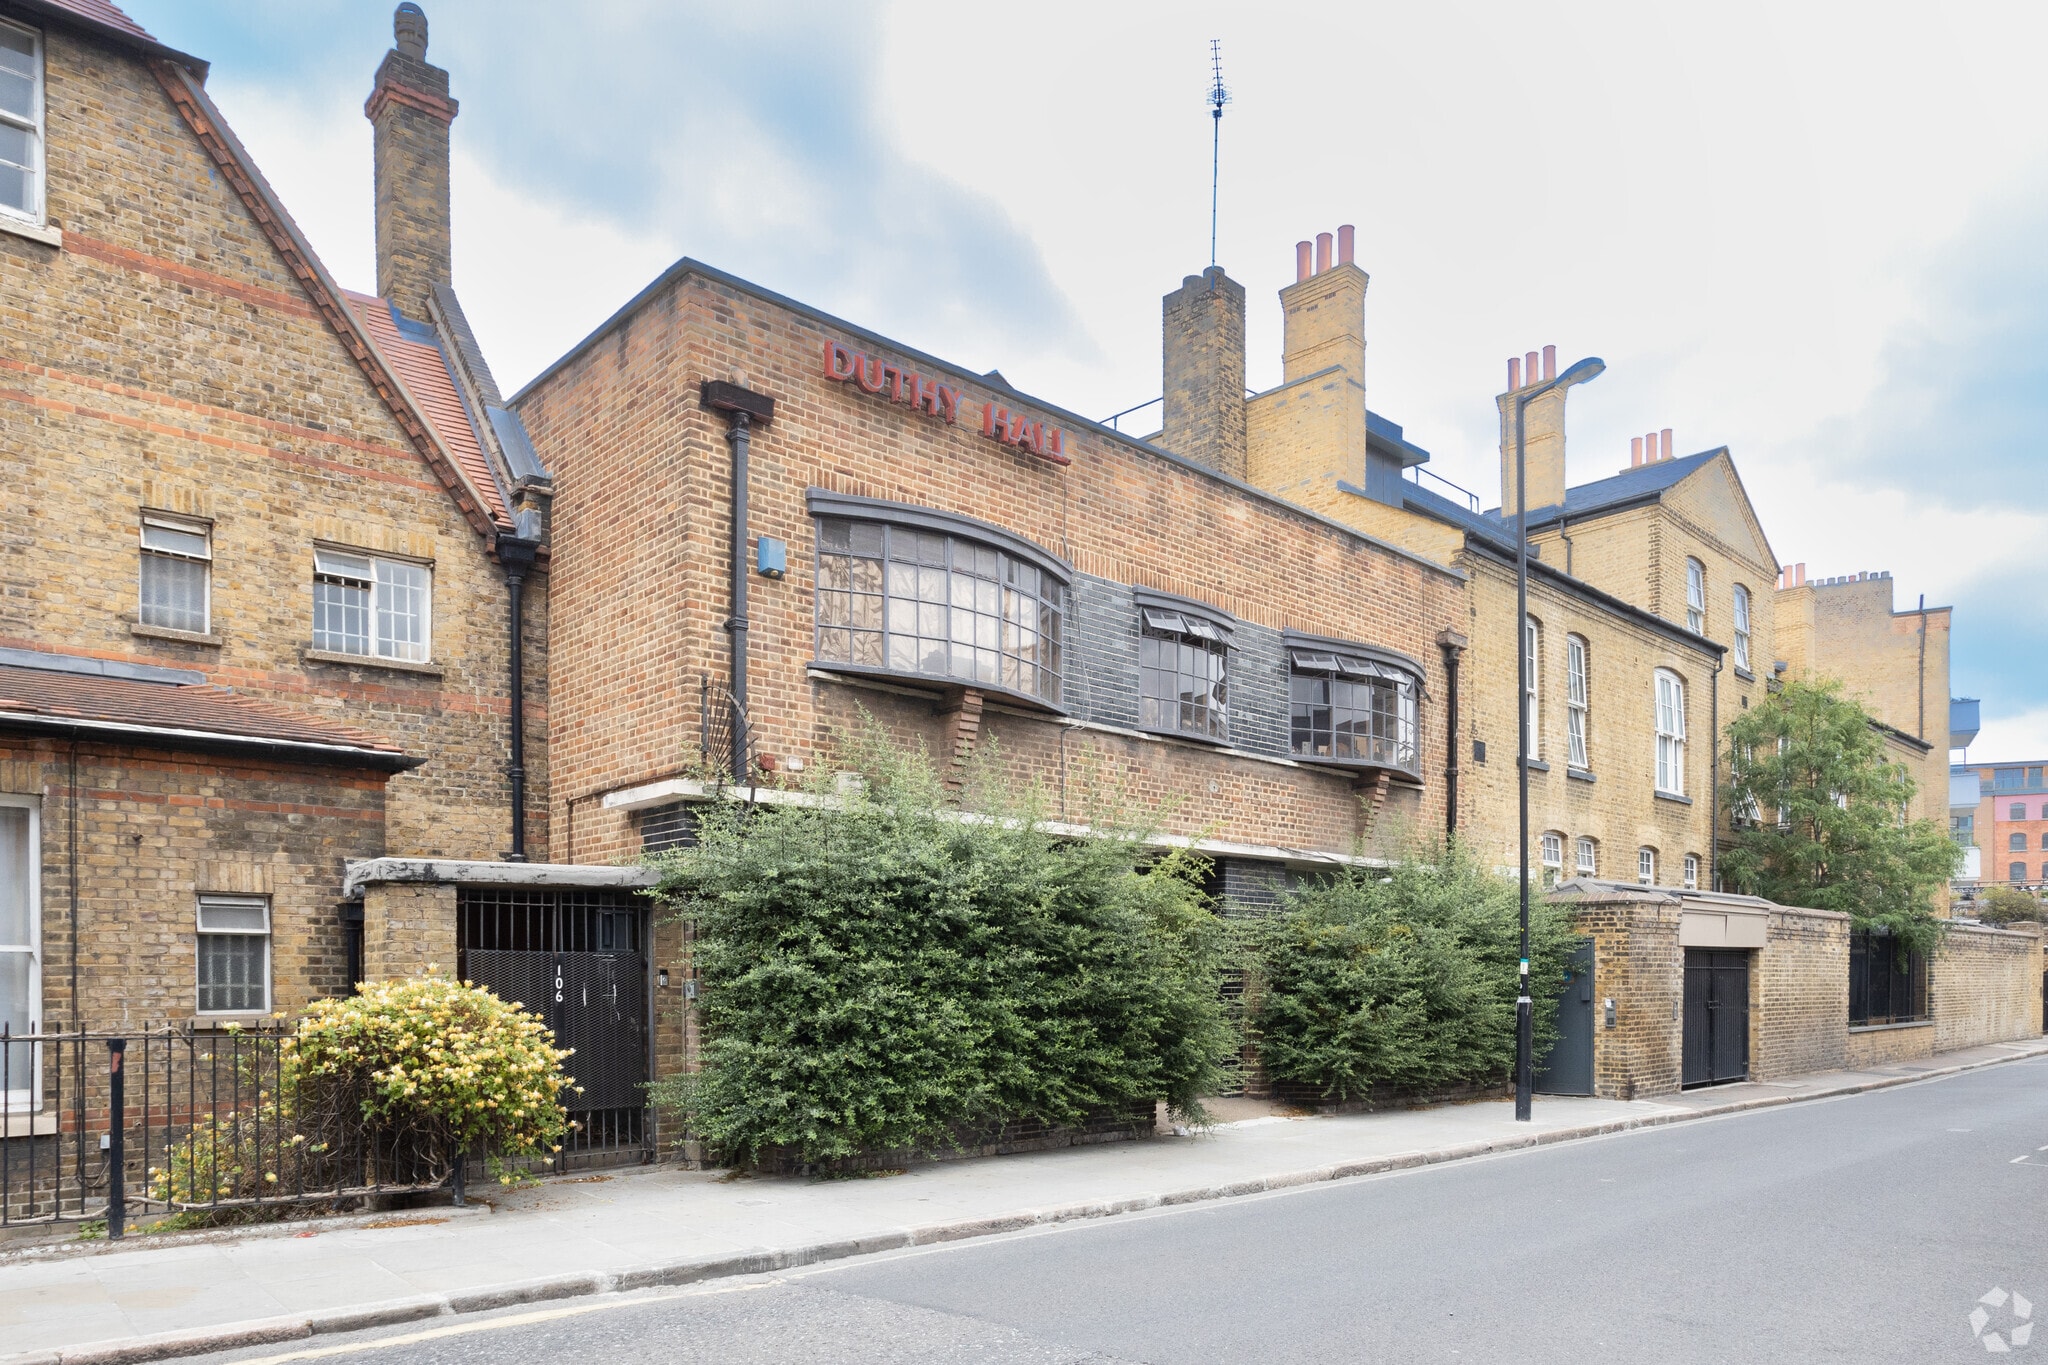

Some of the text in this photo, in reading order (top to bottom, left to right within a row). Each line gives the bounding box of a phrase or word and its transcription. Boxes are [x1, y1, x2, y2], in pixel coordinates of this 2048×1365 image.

[824, 340, 1071, 465] DUTHY HALL
[555, 964, 563, 1002] 106
